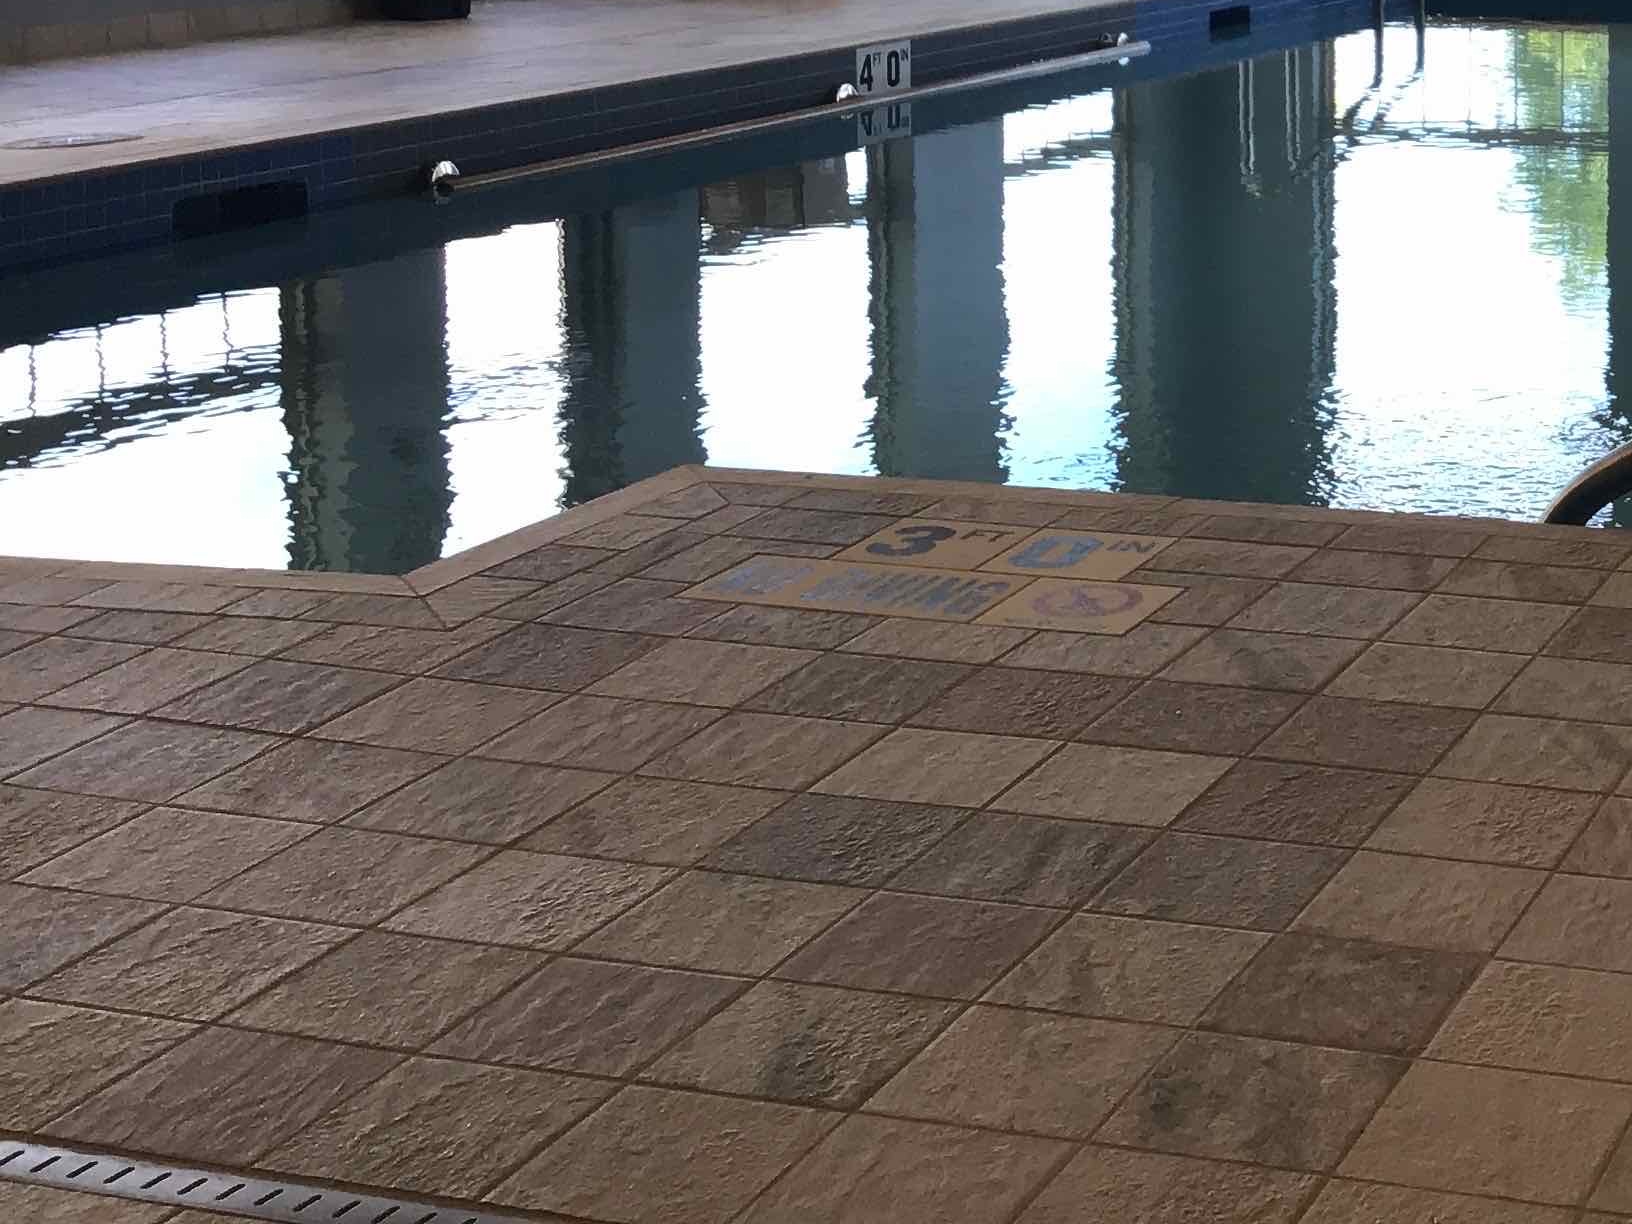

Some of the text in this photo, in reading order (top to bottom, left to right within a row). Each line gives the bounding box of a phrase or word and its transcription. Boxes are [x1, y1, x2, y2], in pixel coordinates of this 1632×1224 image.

[860, 53, 873, 92] 4
[887, 50, 900, 87] 0
[865, 525, 956, 557] 3
